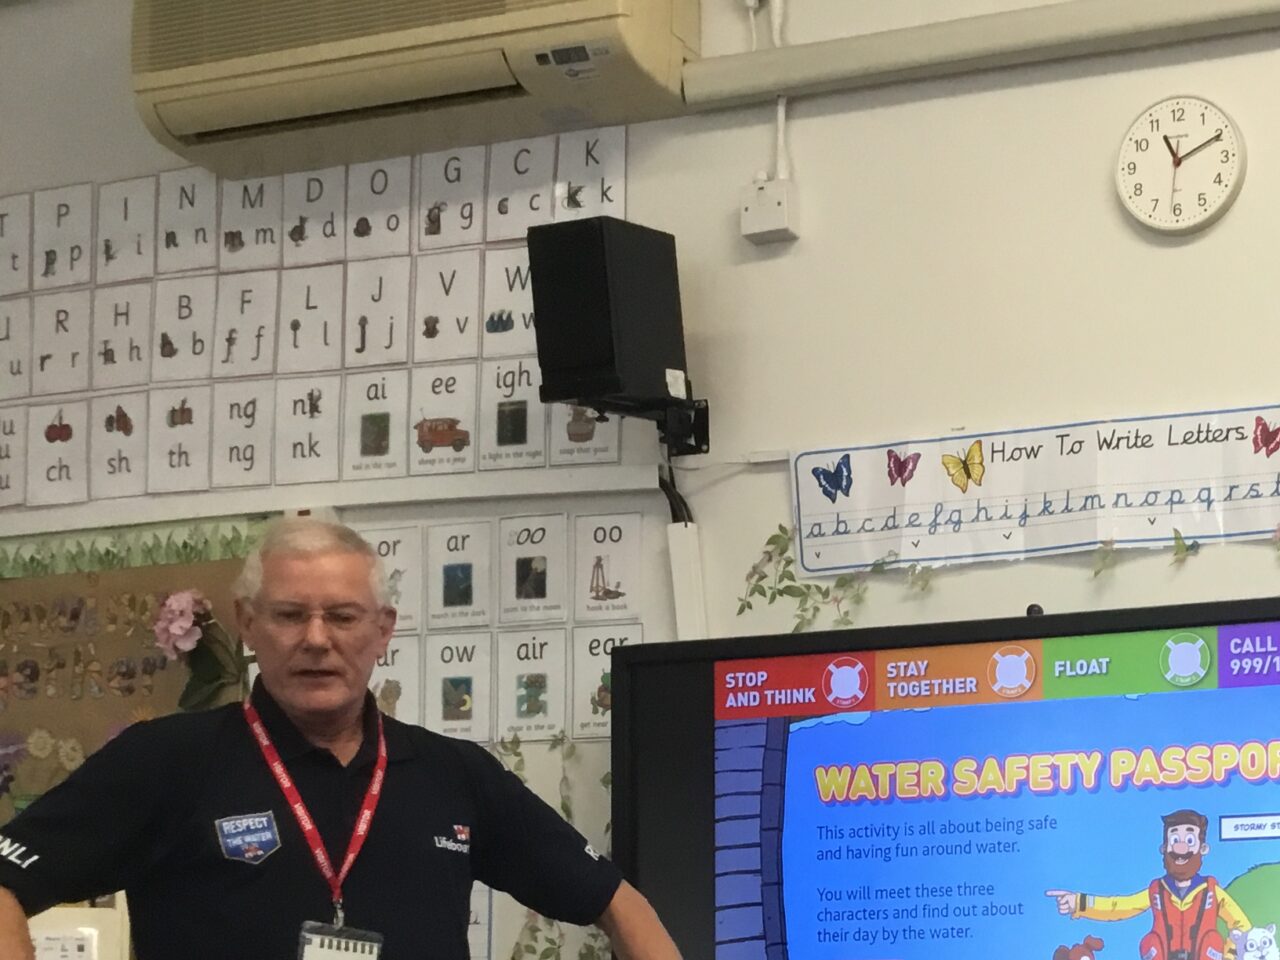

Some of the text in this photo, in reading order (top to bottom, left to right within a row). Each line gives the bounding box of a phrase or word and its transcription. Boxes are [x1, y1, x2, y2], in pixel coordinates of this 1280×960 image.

[1171, 108, 1185, 122] 12
[1200, 113, 1204, 125] 1
[1149, 119, 1159, 132] 11
[1134, 138, 1148, 152] 10
[1220, 150, 1229, 163] 3
[1128, 162, 1136, 175] 9
[1213, 172, 1222, 186] 4
[1134, 183, 1142, 196] 8
[1151, 199, 1159, 212] 7
[1198, 193, 1206, 206] 5
[1173, 203, 1182, 216] 6
[367, 377, 387, 400] ai
[432, 377, 456, 394] ee
[496, 361, 532, 398] igh
[229, 398, 256, 427] ng
[292, 433, 321, 458] nk
[991, 423, 1248, 463] How To Write Letters
[107, 449, 131, 474] sh
[168, 444, 190, 468] th
[229, 444, 254, 470] ng
[46, 459, 71, 482] ch
[447, 533, 470, 552] ar
[516, 527, 546, 545] oo
[593, 526, 622, 543] oo
[440, 645, 475, 663] ow
[516, 637, 547, 660] air
[1230, 636, 1278, 654] CALL
[887, 660, 928, 678] STAY
[1054, 658, 1110, 677] FLOAT
[725, 671, 768, 688] STOP
[887, 678, 977, 697] TOGETHER
[725, 692, 760, 708] AND
[766, 688, 816, 706] THINK
[814, 759, 947, 802] WATER
[951, 750, 1103, 797] SAFETY
[223, 818, 267, 833] RESPECT
[294, 803, 312, 830] VISITOR
[817, 815, 1057, 840] This activity is all about being safe
[1234, 823, 1267, 831] STORMY
[0, 836, 39, 869] NLI
[817, 840, 1020, 862] and having fun around water.
[817, 882, 994, 902] You will meet these three
[817, 902, 1024, 922] characters and find out about
[817, 926, 973, 944] their day by the water.
